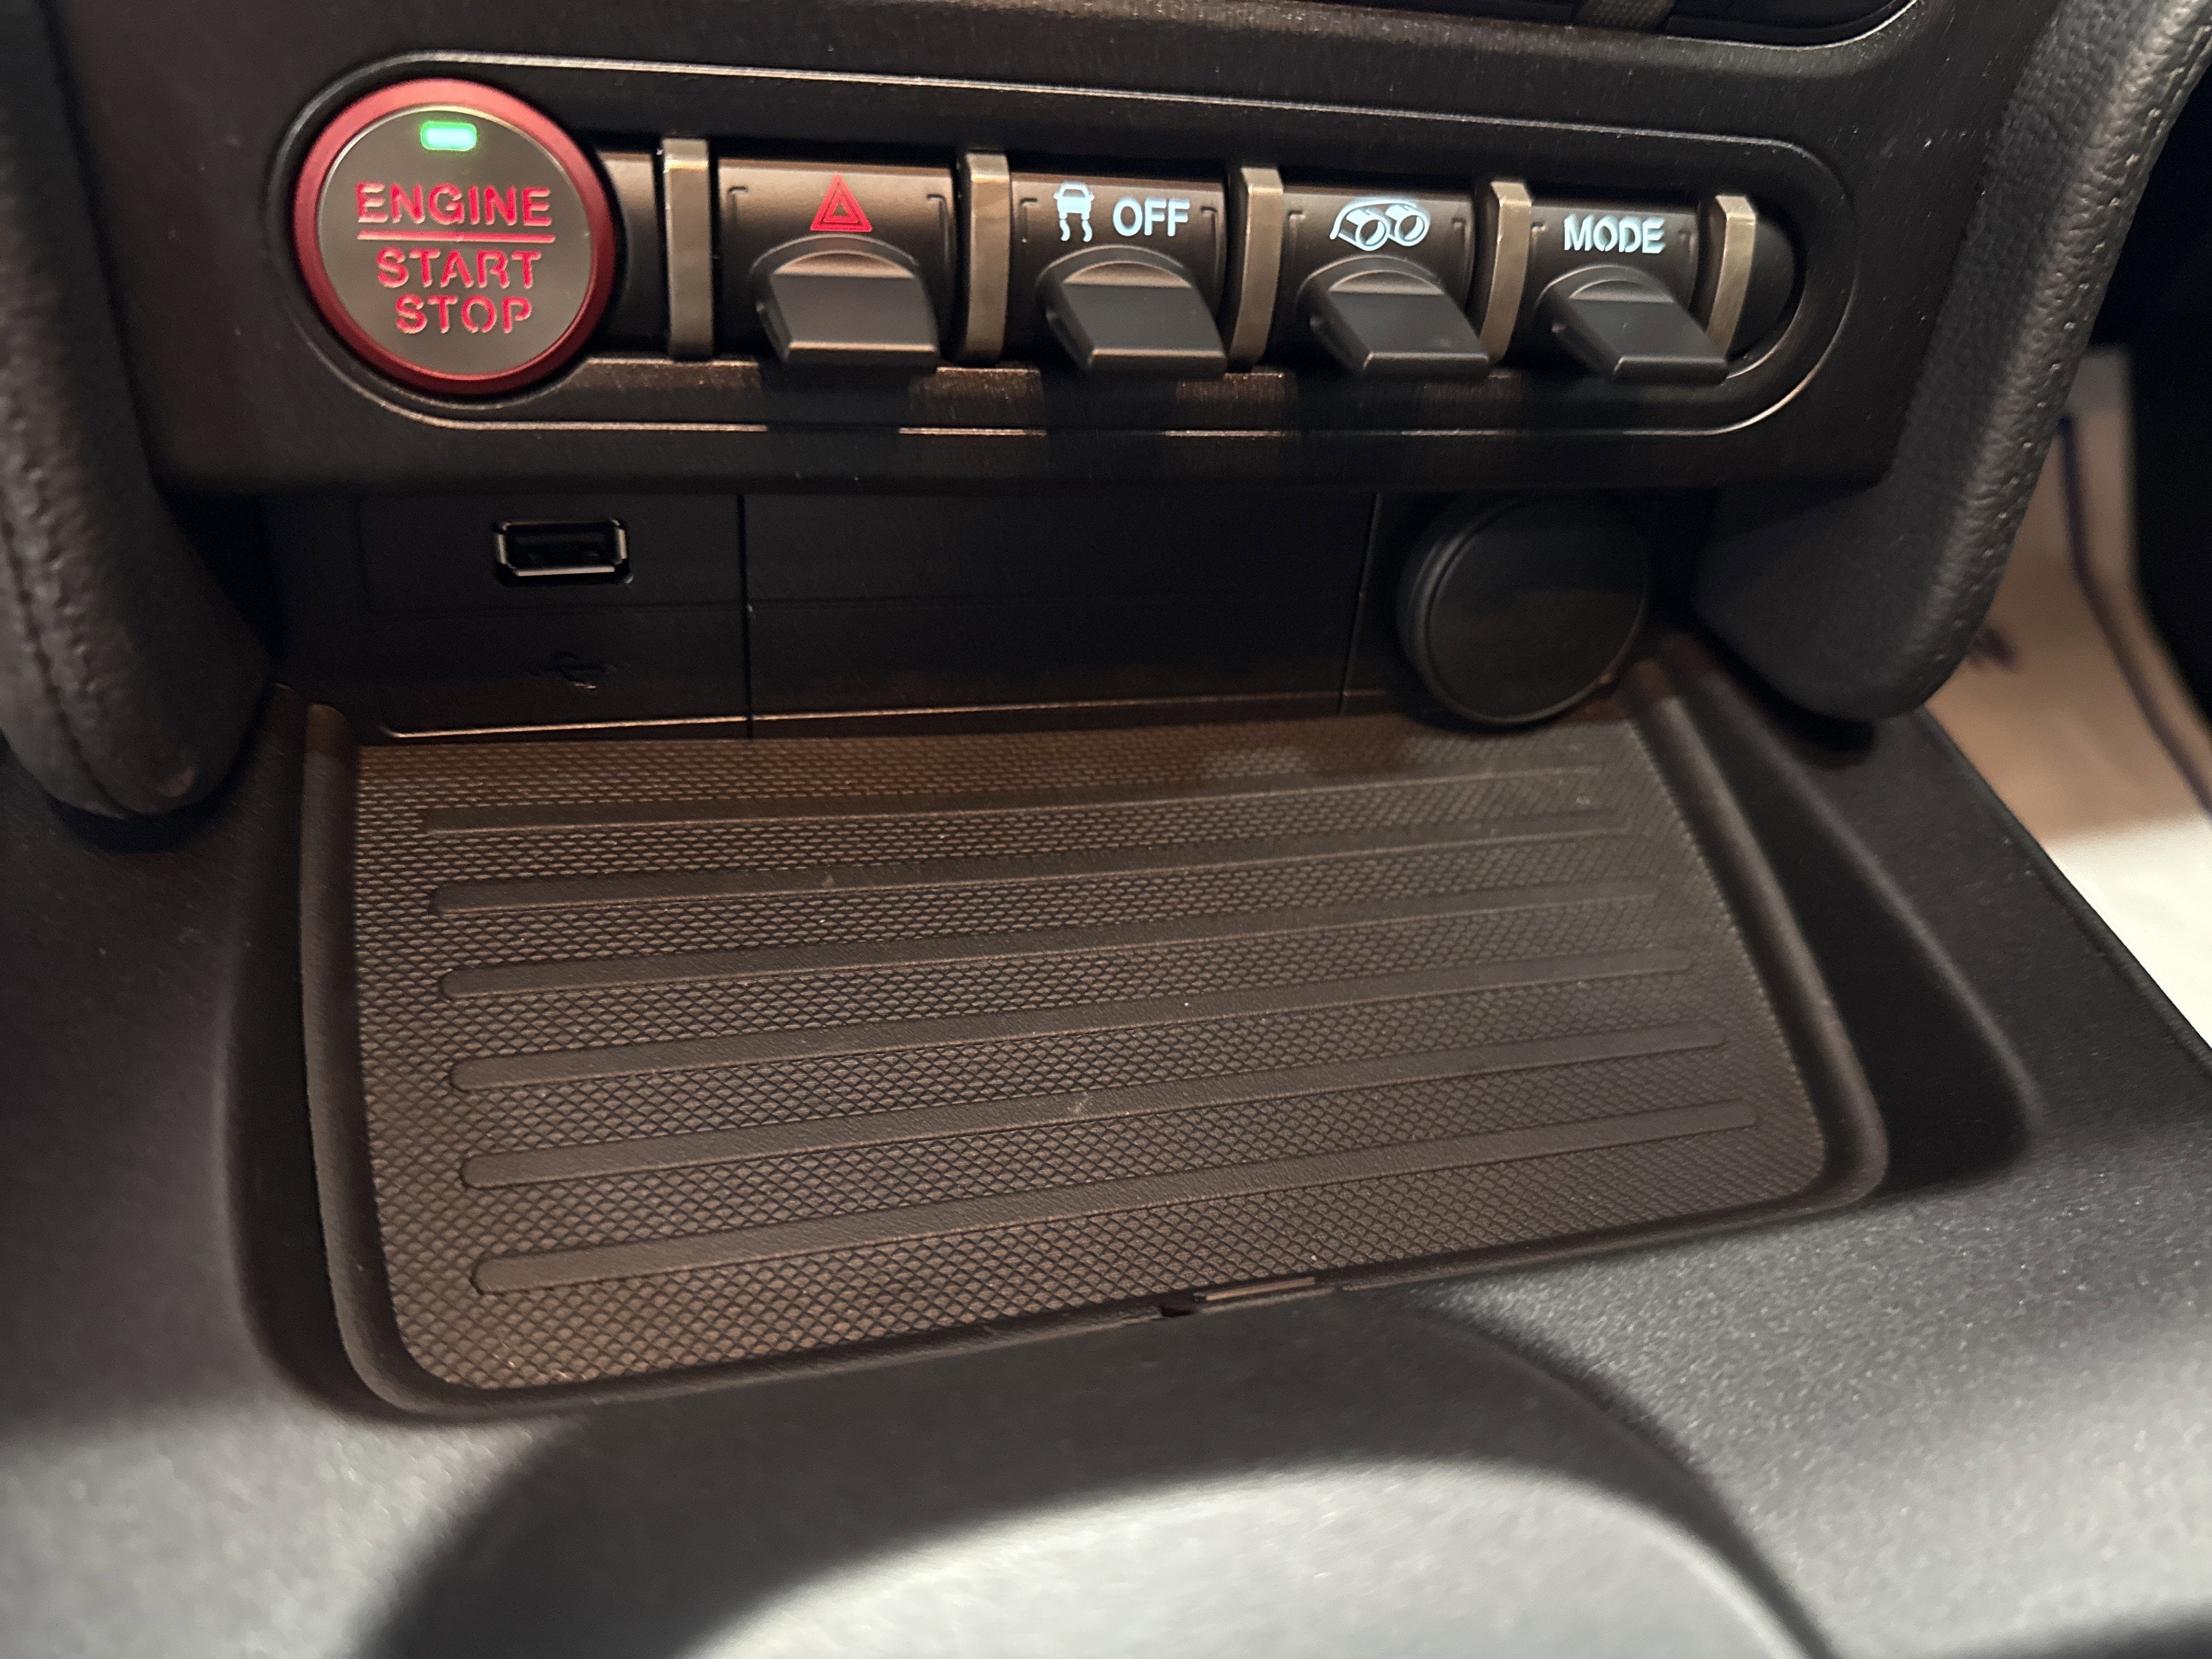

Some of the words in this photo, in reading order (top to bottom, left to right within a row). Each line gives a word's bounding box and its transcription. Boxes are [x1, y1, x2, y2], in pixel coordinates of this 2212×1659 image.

[356, 182, 552, 227] ENGINE
[1112, 198, 1190, 236] OFF
[1564, 214, 1665, 254] MODE
[377, 247, 541, 288] START
[395, 294, 532, 334] STOP
